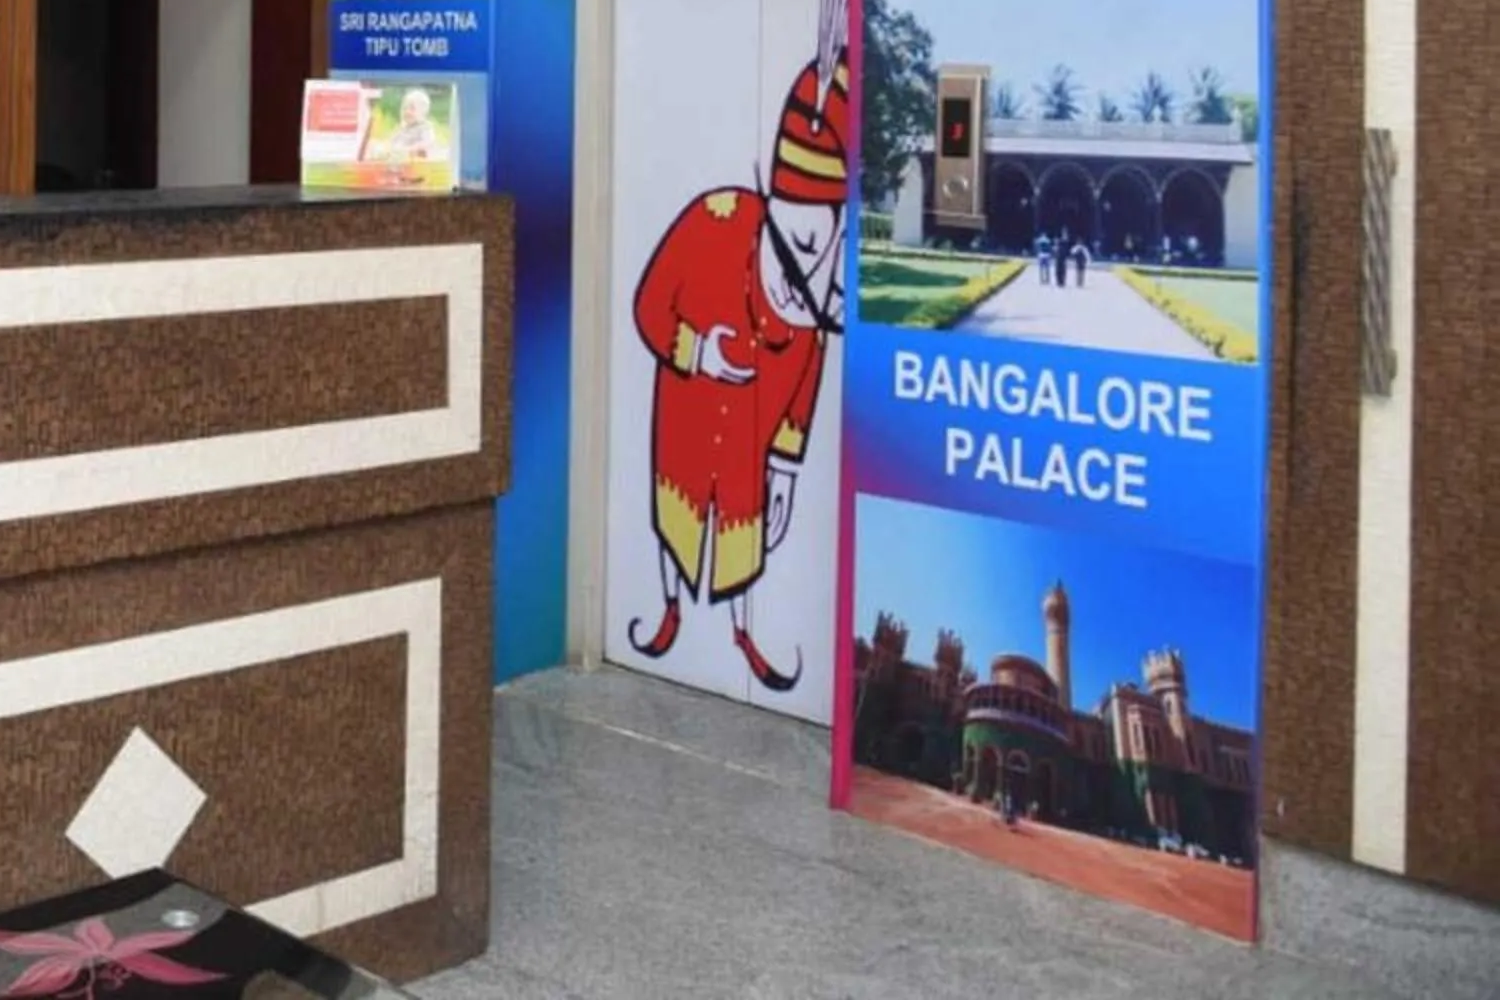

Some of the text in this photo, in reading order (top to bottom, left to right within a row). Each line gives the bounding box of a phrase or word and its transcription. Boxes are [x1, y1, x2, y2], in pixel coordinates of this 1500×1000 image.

[340, 11, 478, 32] SRI RANGAPATNA
[365, 37, 449, 57] TIPU TOMB
[894, 350, 1213, 442] BANGALORE
[945, 427, 1148, 507] PALACE
